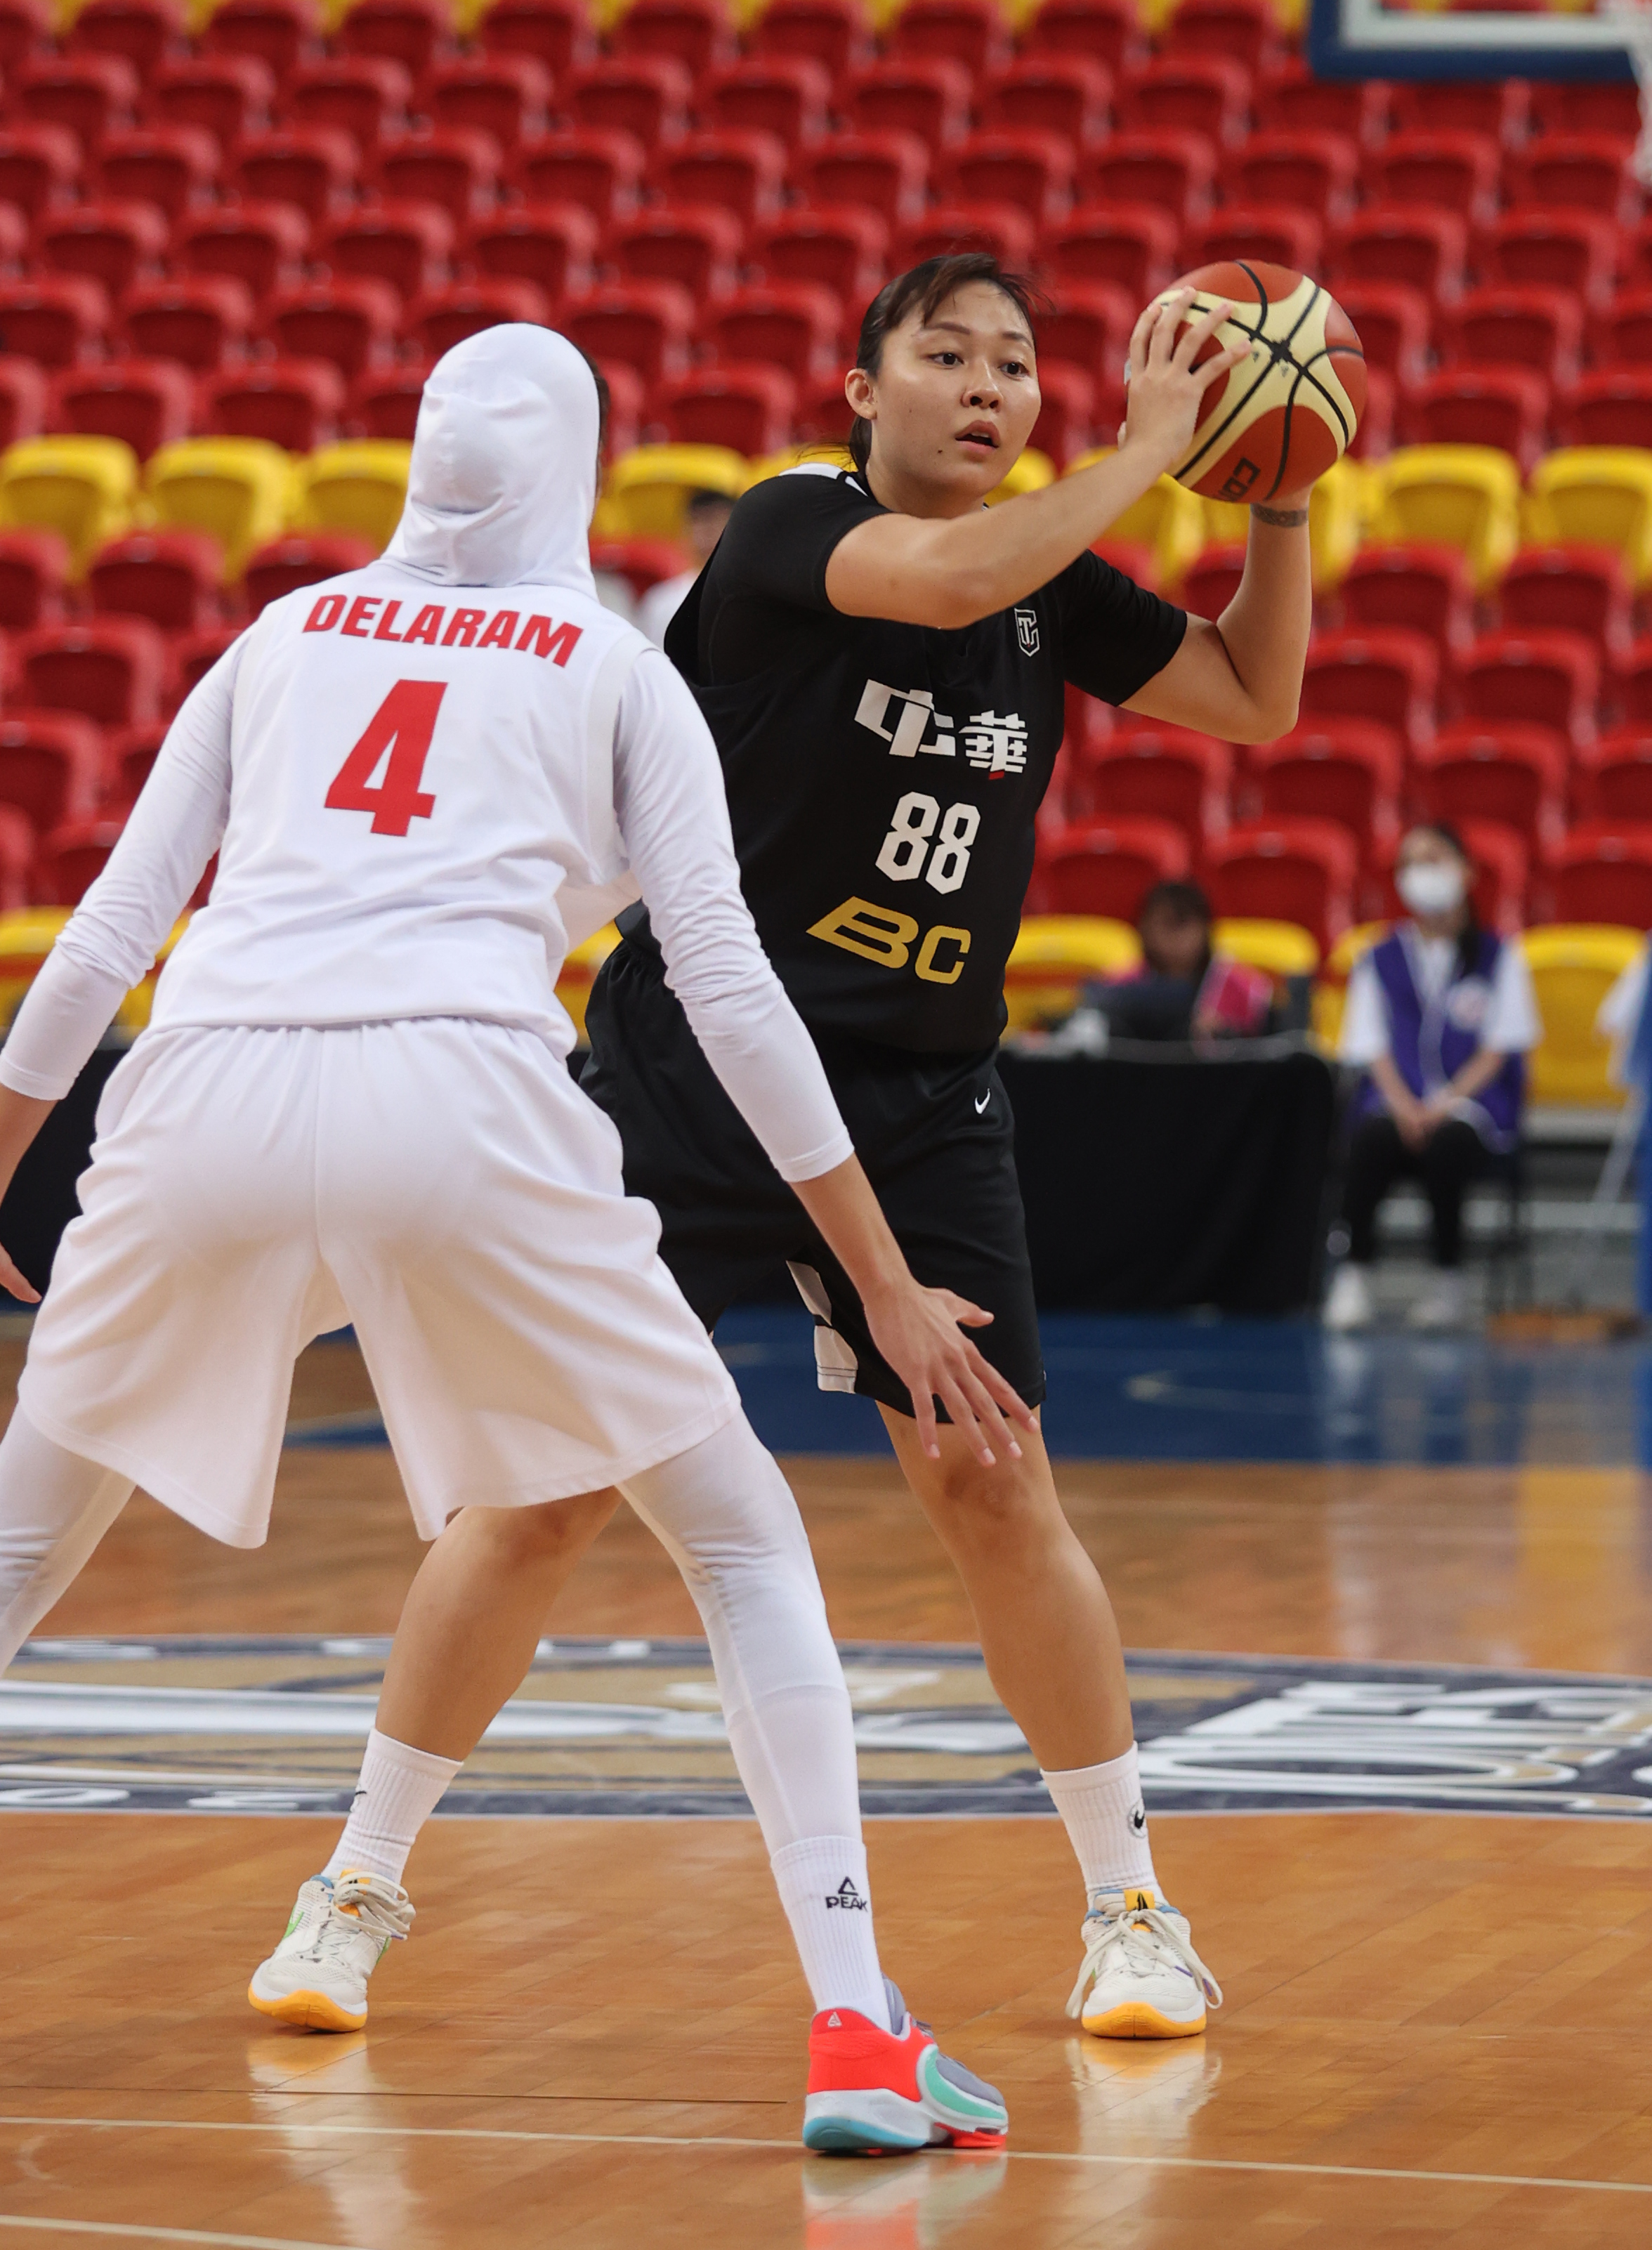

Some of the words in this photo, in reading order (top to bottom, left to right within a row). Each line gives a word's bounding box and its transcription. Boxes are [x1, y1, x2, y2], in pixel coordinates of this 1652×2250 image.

[302, 594, 584, 668] DELARAM
[324, 679, 449, 837] 4
[854, 679, 1028, 780] 中華
[875, 791, 981, 896] 88
[806, 896, 971, 985] BC
[825, 1895, 868, 1912] PEAK
